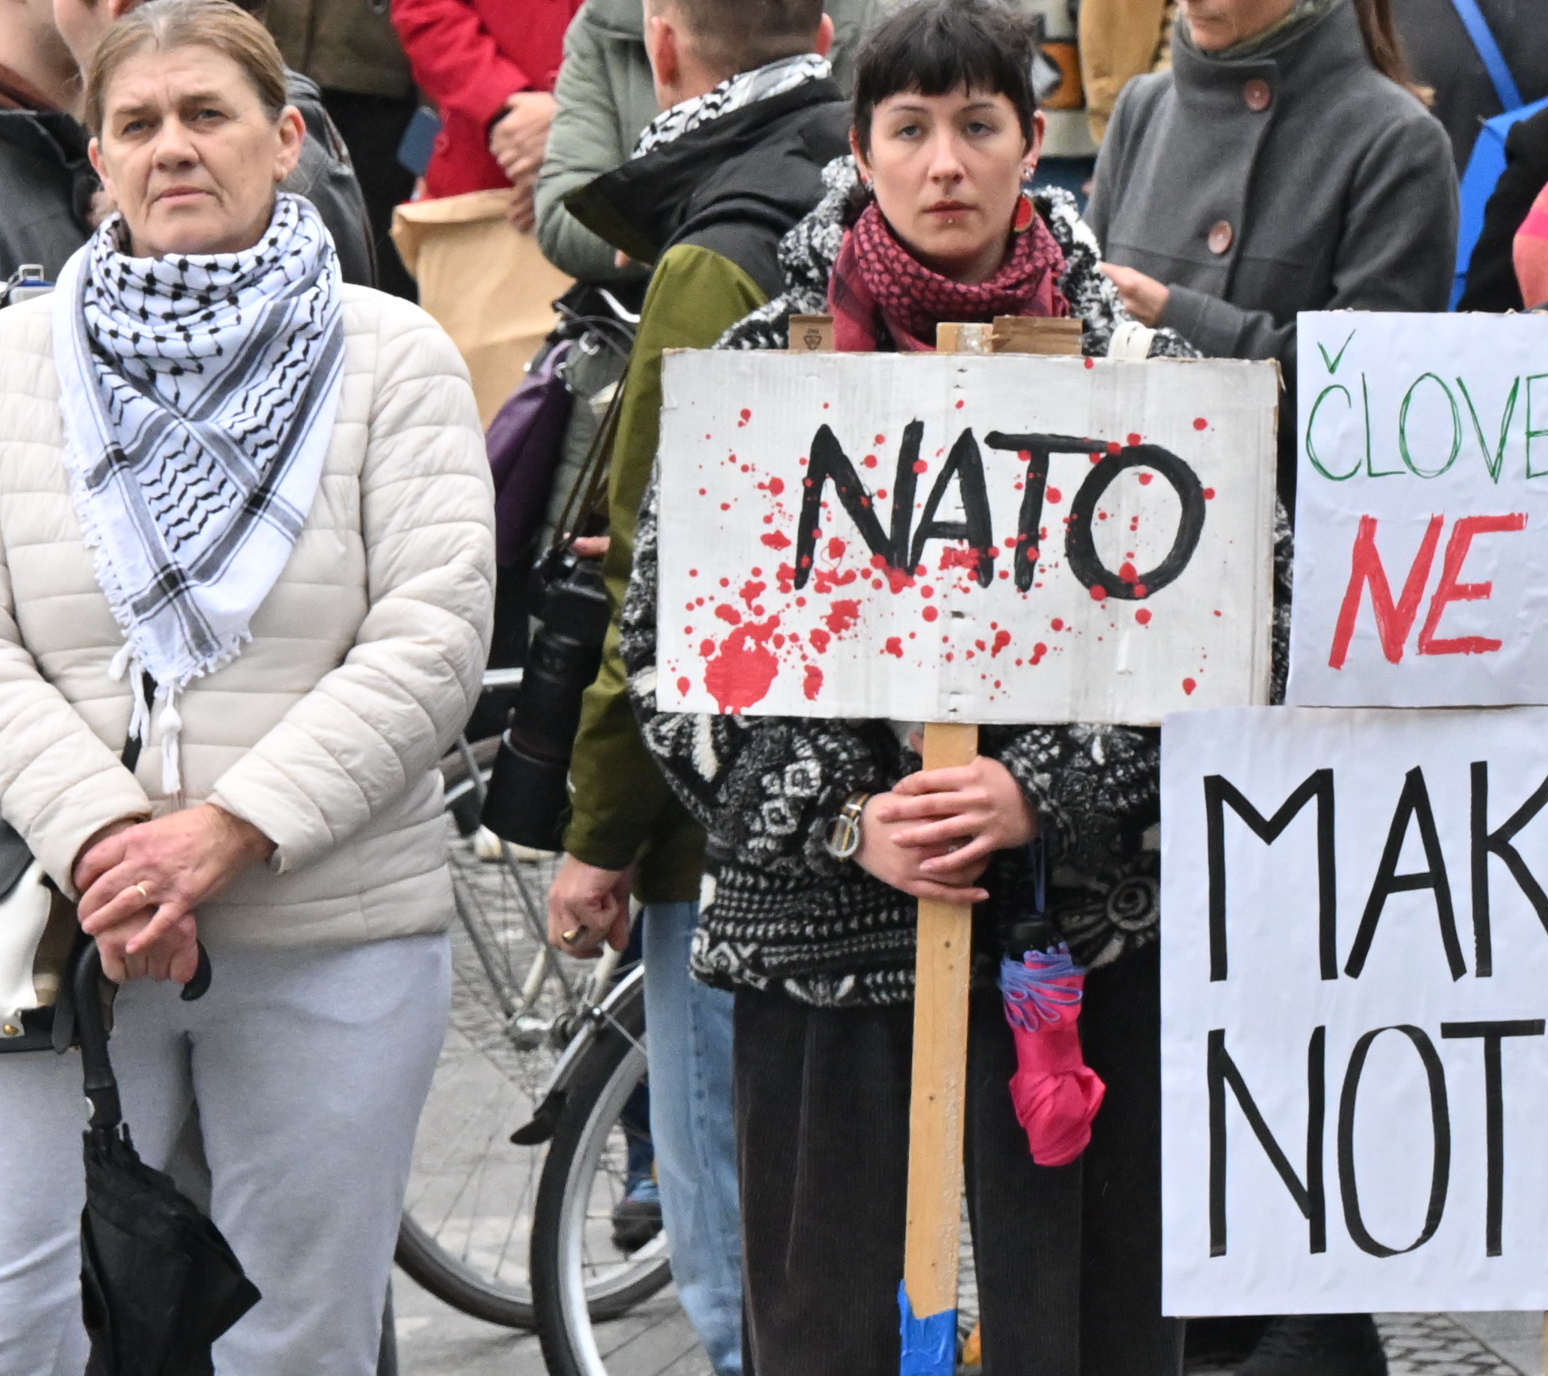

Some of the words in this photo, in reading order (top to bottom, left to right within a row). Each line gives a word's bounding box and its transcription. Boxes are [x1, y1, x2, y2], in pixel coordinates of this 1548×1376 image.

[794, 418, 1207, 601] NATO
[1327, 510, 1529, 671] NE
[1207, 1018, 1546, 1259] NOT
